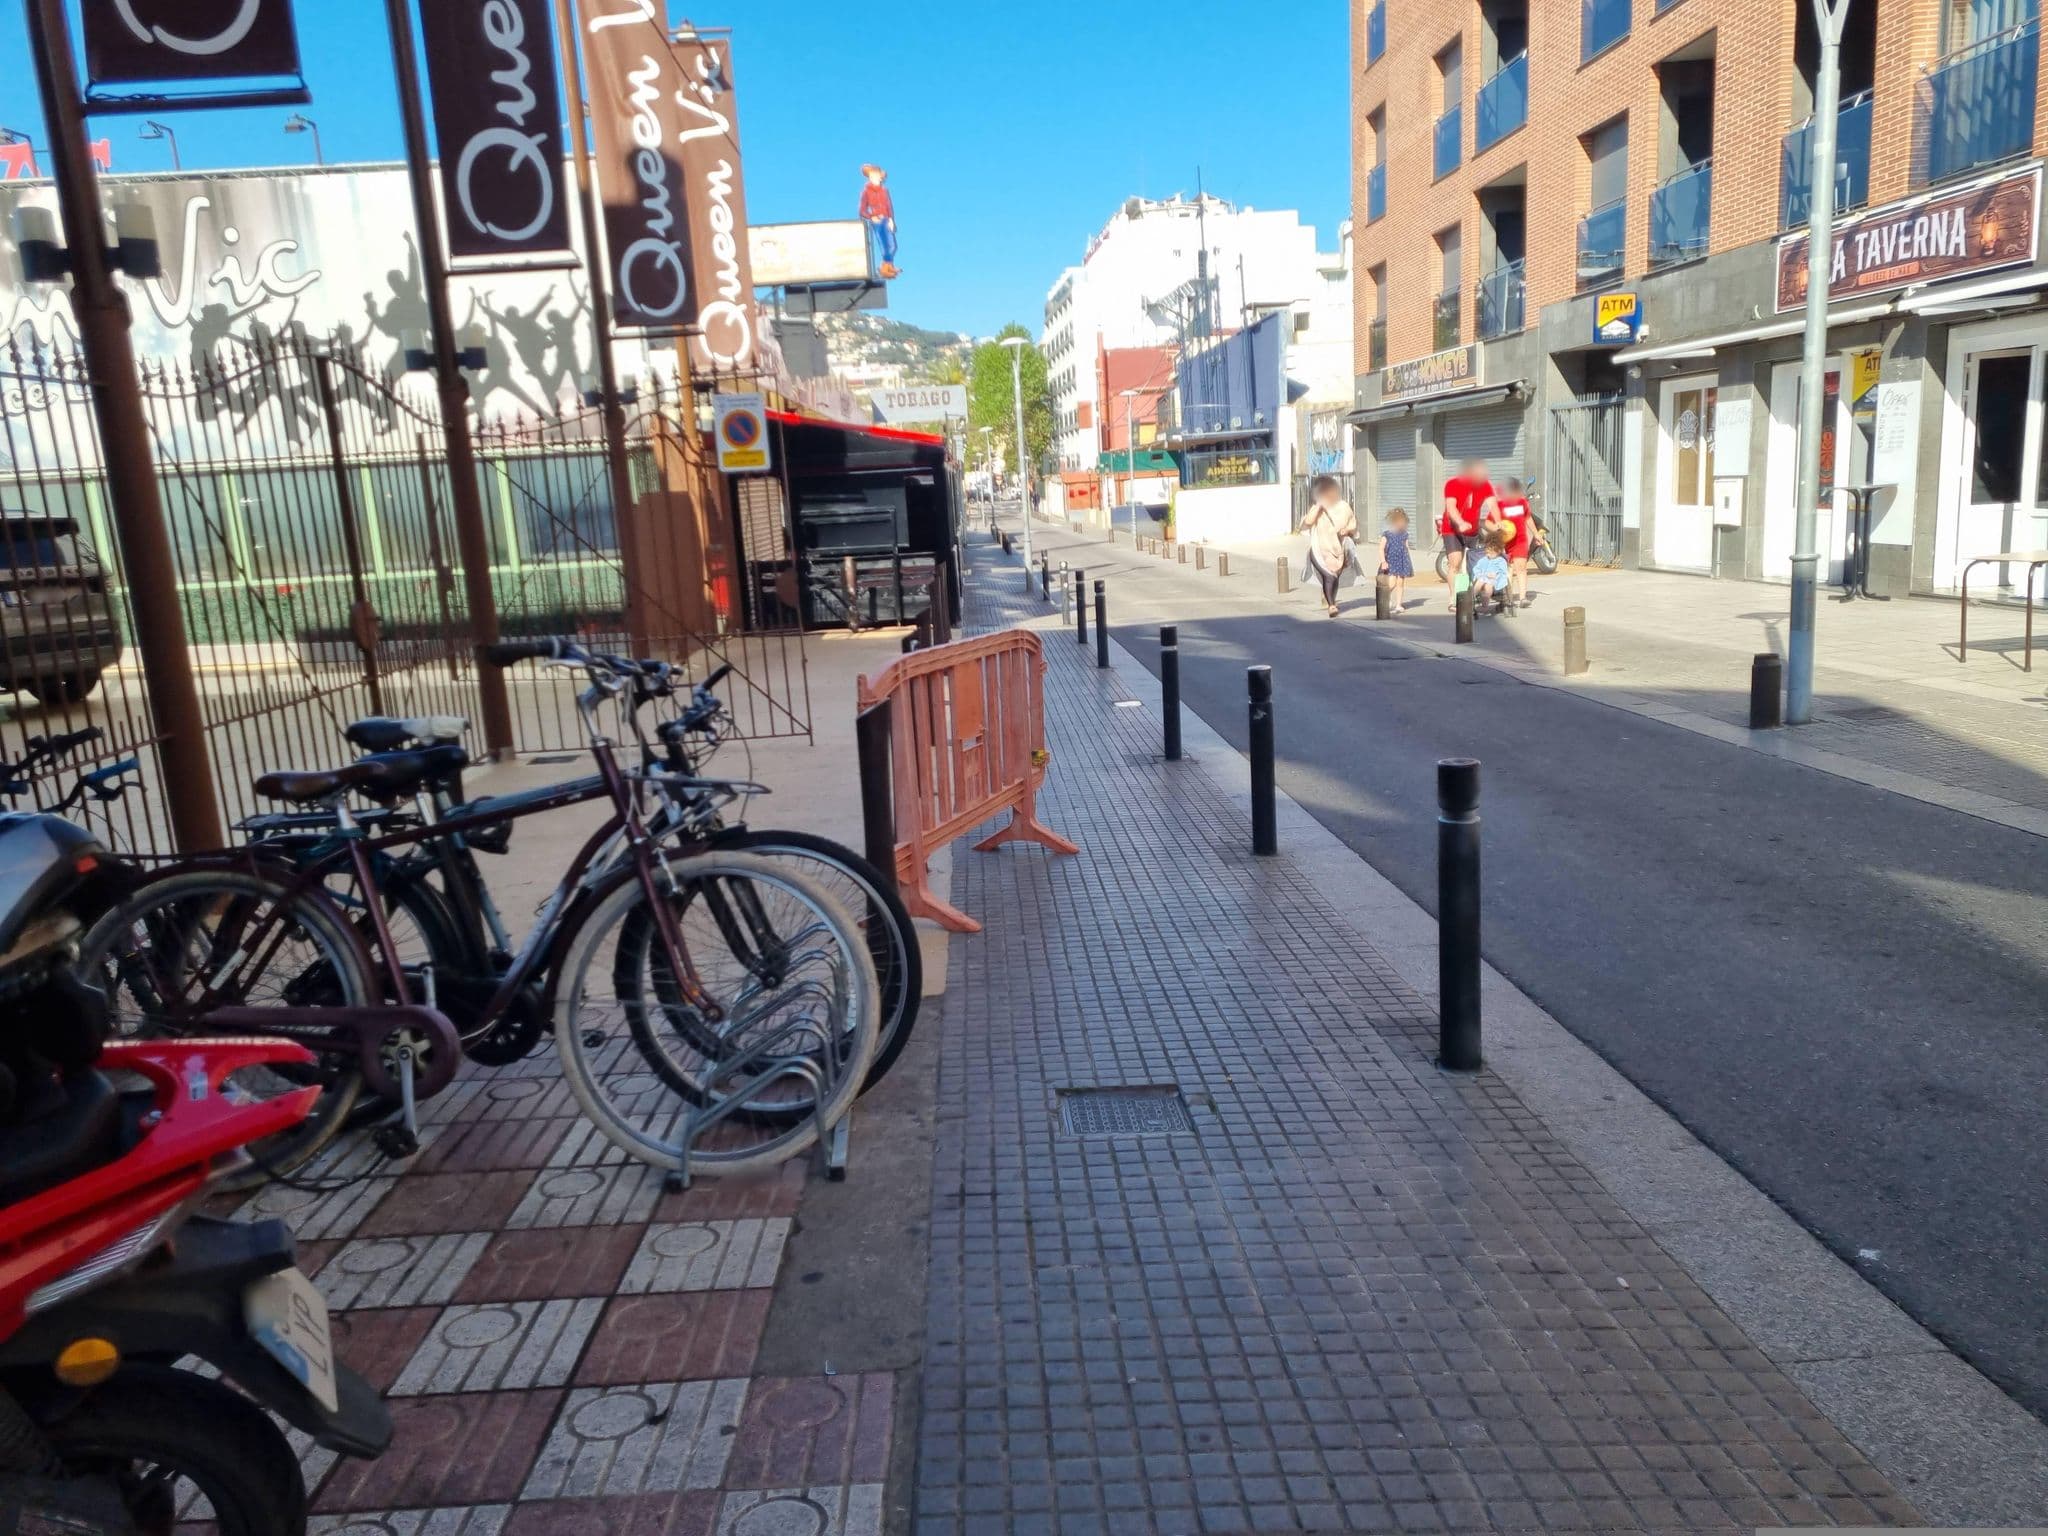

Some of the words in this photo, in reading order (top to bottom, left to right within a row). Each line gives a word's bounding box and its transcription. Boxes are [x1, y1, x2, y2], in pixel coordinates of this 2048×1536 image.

[619, 54, 687, 318] Queen
[122, 196, 322, 328] Vic
[698, 158, 753, 364] Queen
[1854, 206, 1968, 273] TAVERNA
[1601, 298, 1633, 311] ATM
[885, 390, 951, 409] TOBAGO
